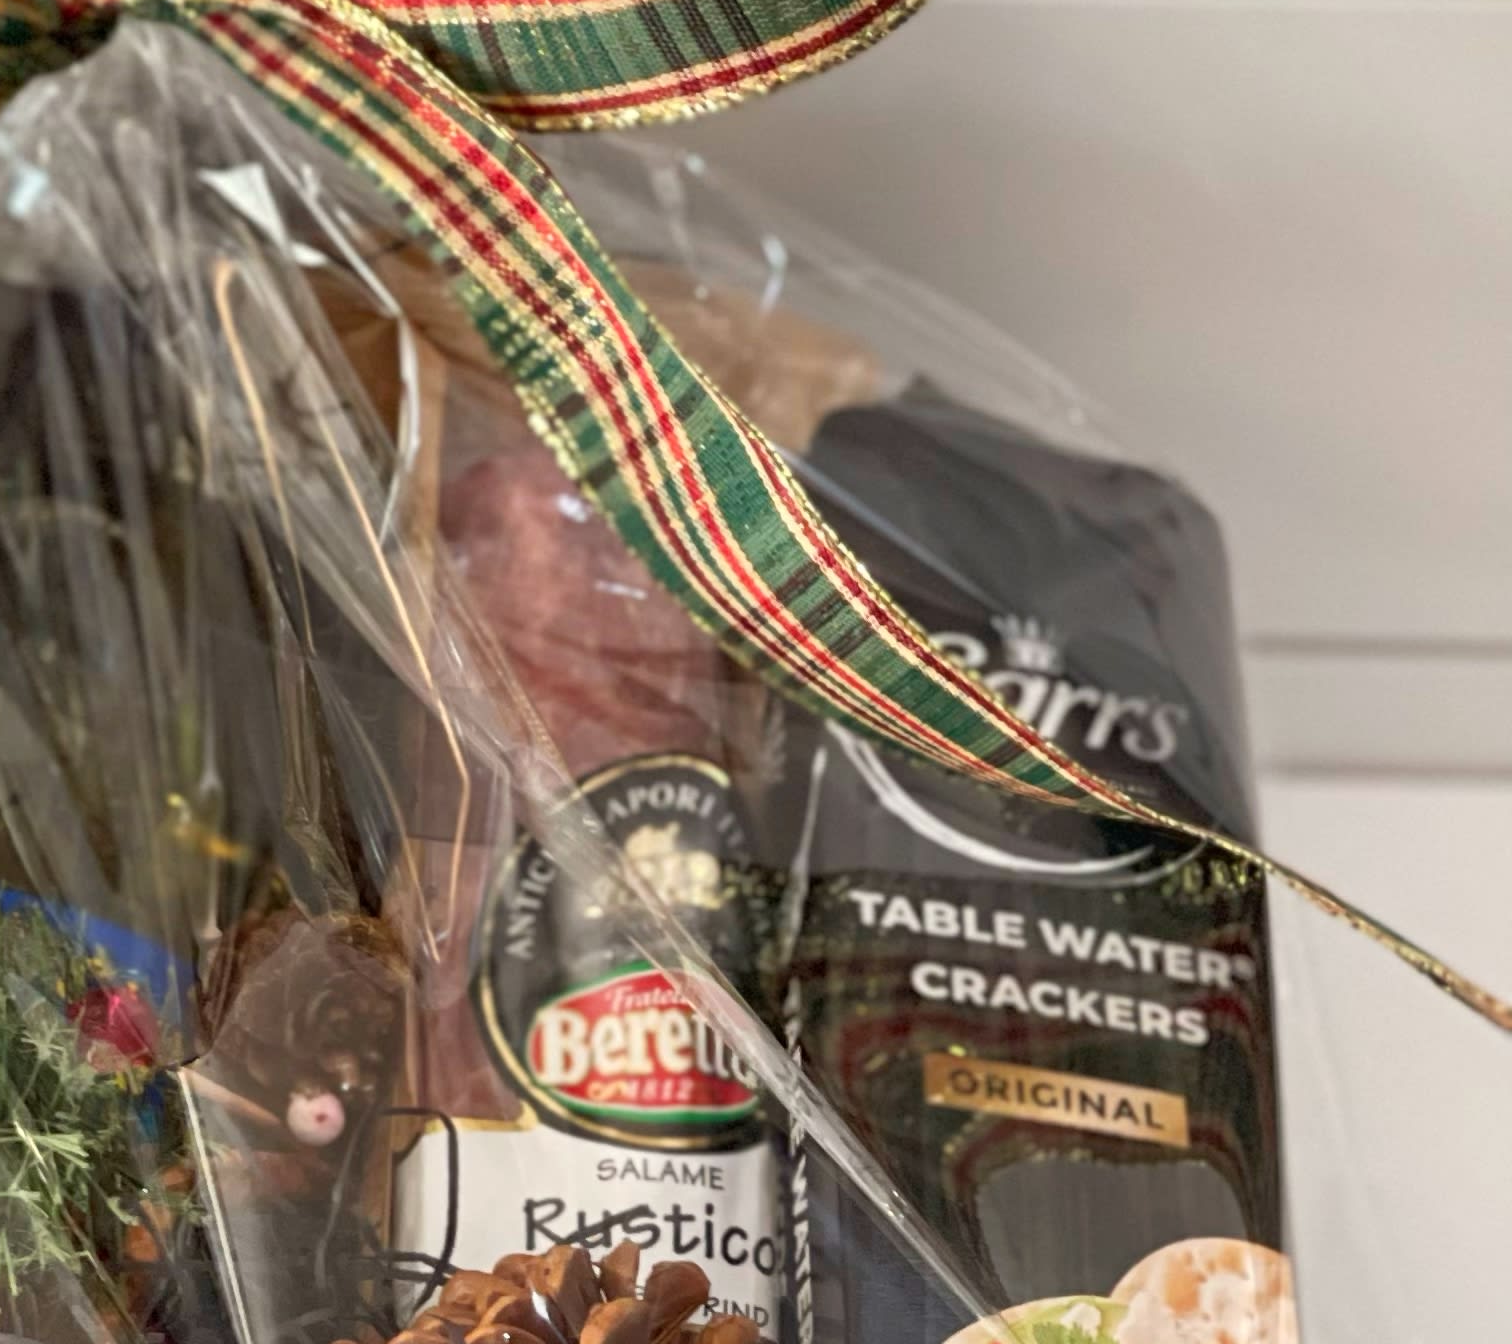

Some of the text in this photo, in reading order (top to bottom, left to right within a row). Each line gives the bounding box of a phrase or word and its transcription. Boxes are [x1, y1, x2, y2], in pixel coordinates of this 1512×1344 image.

[850, 889, 1027, 950] TABLE
[911, 963, 1209, 1046] CRACKERS
[948, 1068, 1165, 1131] ORIGINAL
[596, 1157, 725, 1191] SALAME
[522, 1197, 778, 1277] Rustico
